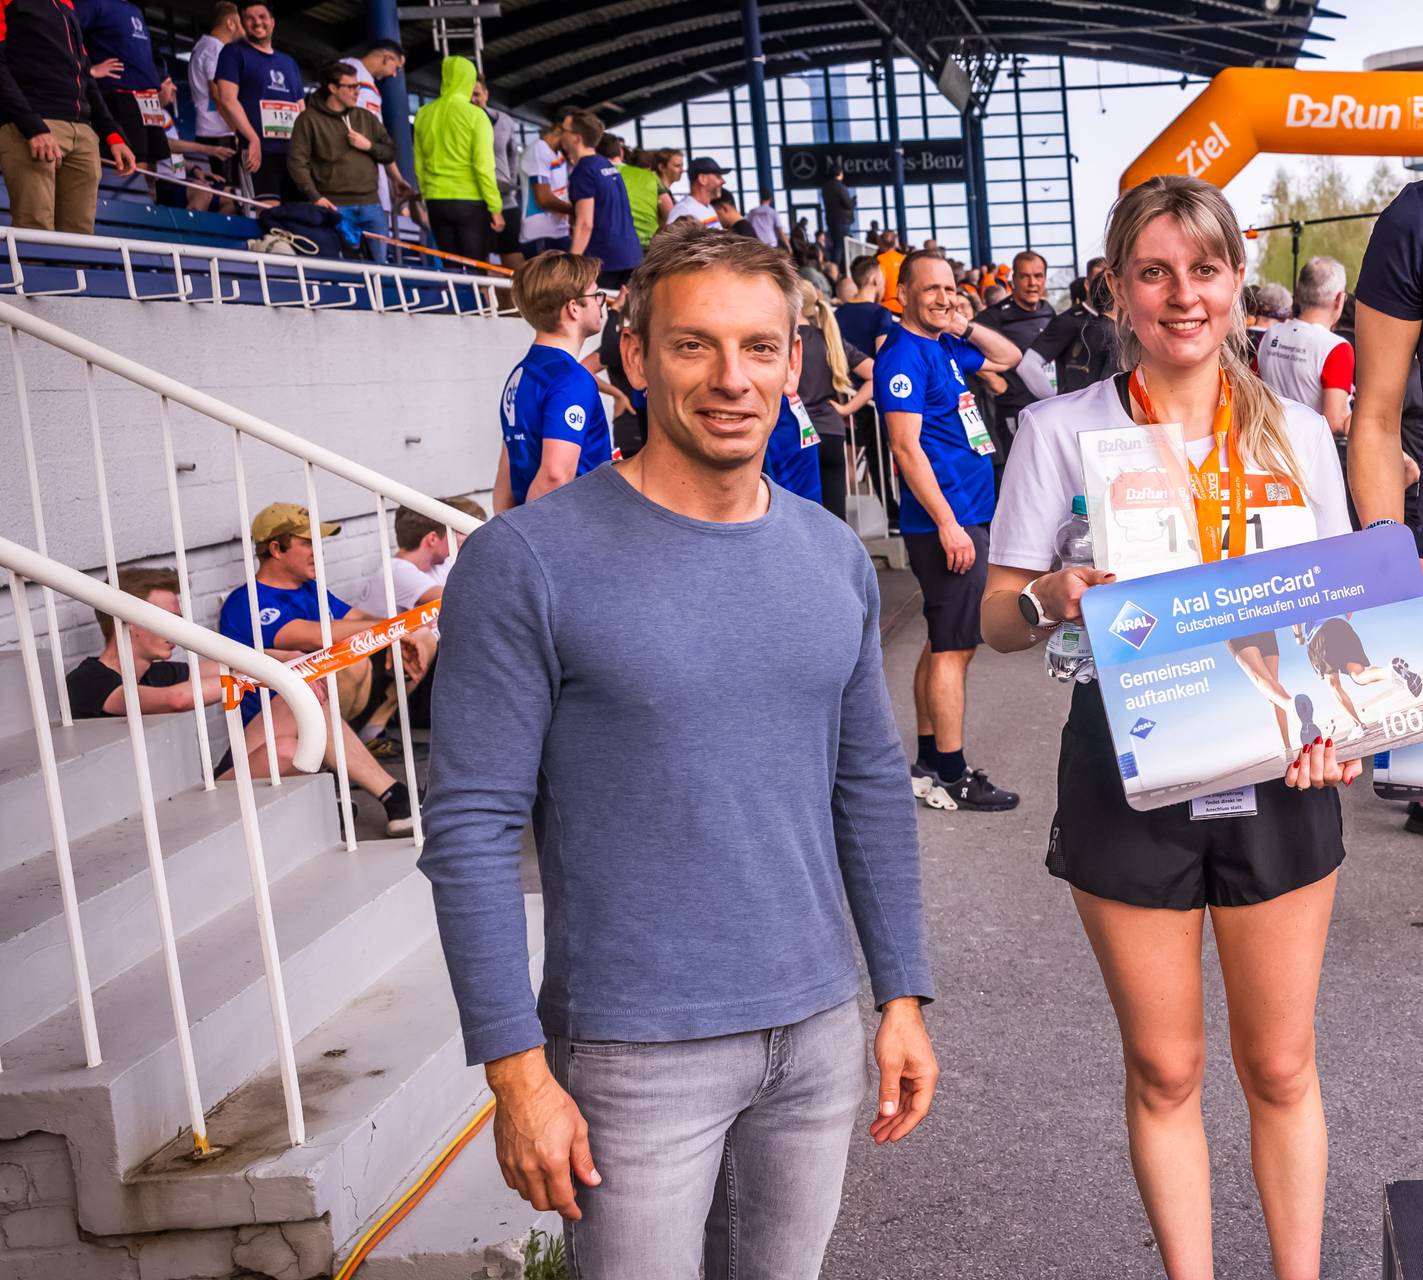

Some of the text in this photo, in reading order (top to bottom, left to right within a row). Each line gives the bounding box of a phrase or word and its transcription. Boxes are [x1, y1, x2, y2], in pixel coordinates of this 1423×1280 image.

[1285, 93, 1401, 130] B2Run
[826, 151, 964, 173] Merces-Benz
[1176, 121, 1231, 178] Ziel
[1171, 591, 1210, 617] Aral
[1175, 583, 1365, 636] Gutschein Einkaufen und Tanken
[1116, 616, 1152, 633] ARAL
[1119, 655, 1216, 689] Gemeinsam
[1125, 677, 1211, 711] auftanken!
[1131, 721, 1153, 732] ARAL
